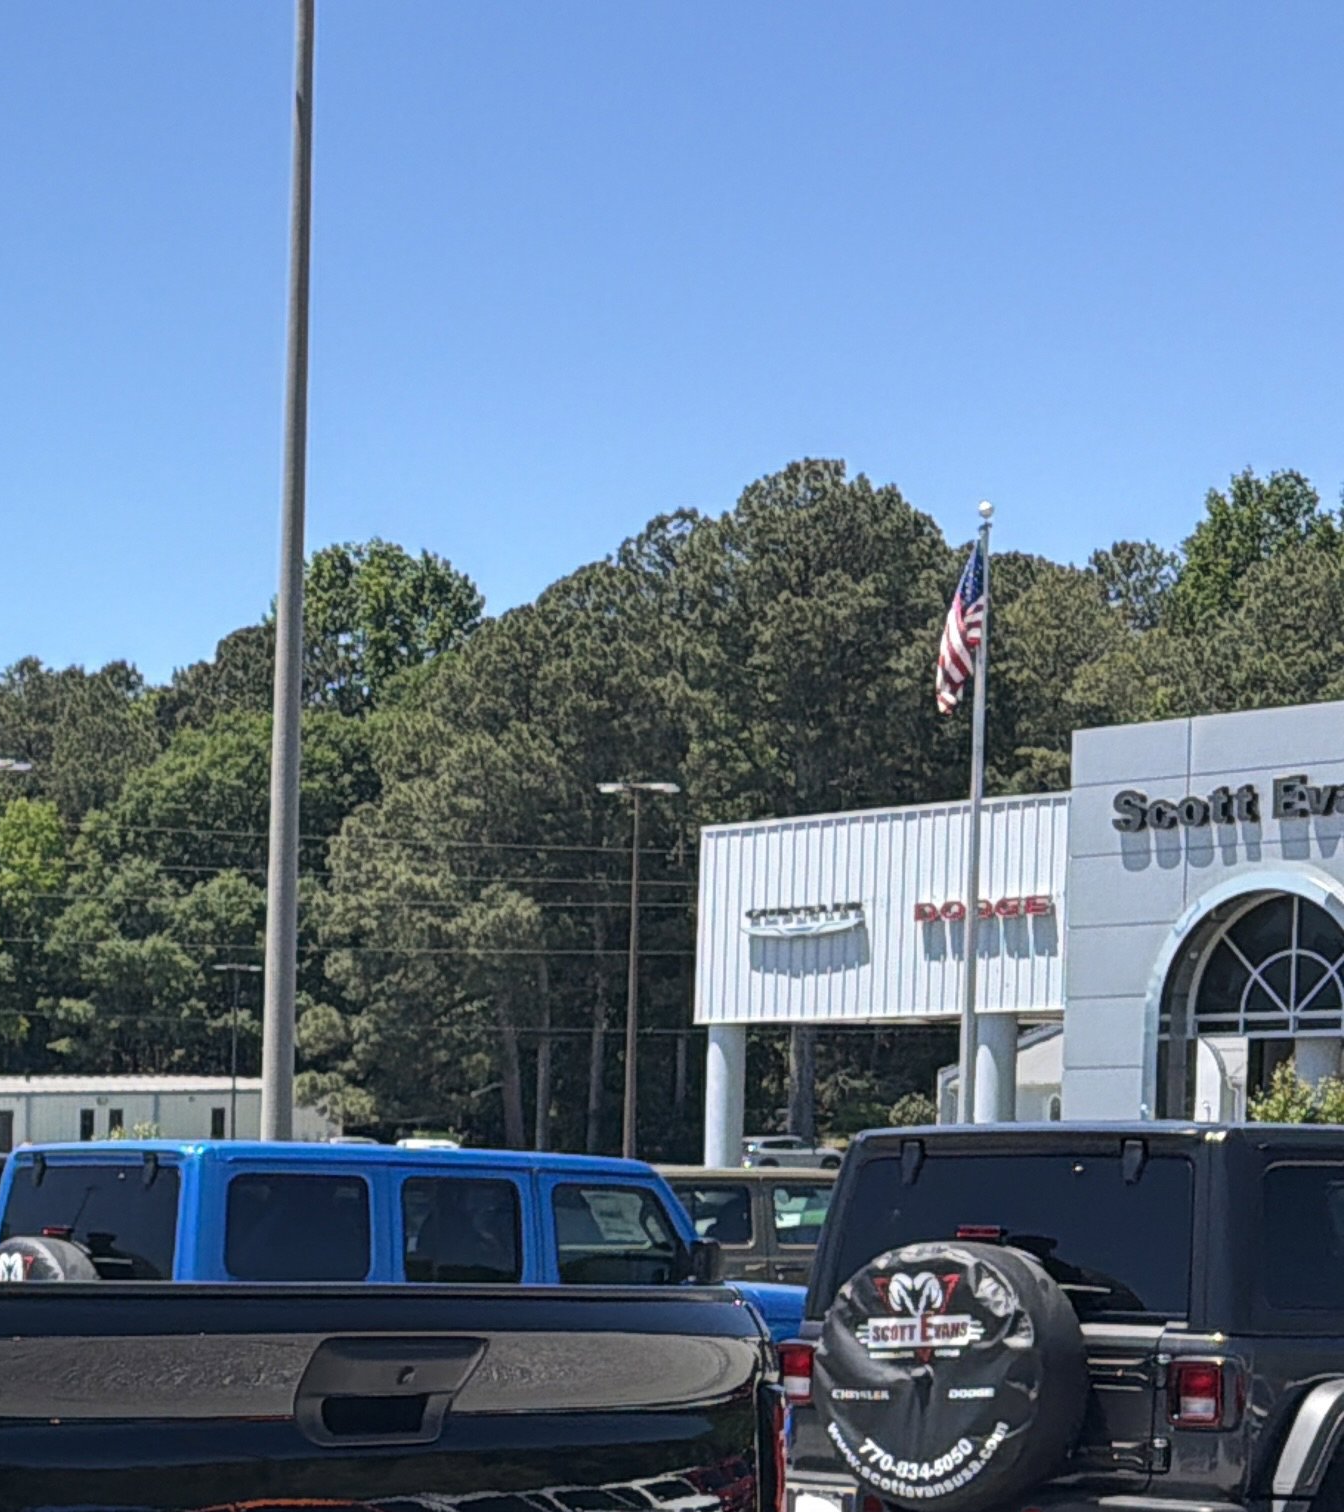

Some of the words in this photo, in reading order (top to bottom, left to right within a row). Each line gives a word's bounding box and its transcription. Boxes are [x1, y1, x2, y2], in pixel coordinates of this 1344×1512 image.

[1112, 784, 1261, 832] Scott
[872, 1324, 917, 1342] SCOTT
[920, 1313, 969, 1342] EVANS
[948, 1387, 996, 1399] DODGE
[859, 1437, 974, 1481] 770-834-5050
